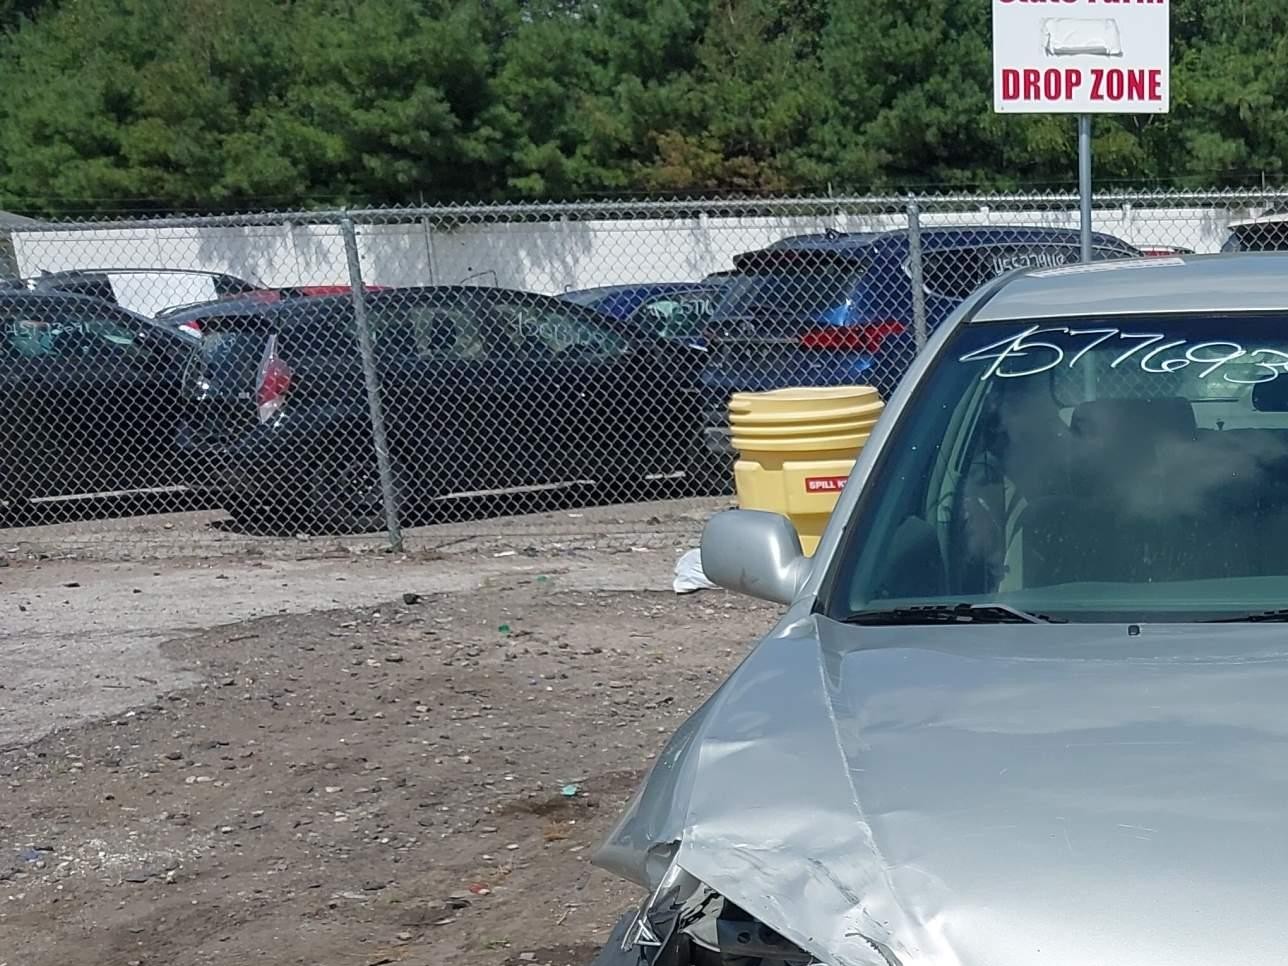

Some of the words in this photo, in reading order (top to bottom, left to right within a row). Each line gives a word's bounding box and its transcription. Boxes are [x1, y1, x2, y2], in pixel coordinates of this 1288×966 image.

[1002, 69, 1082, 100] DROP
[1090, 69, 1162, 100] ZONE
[808, 480, 837, 490] SPILL
